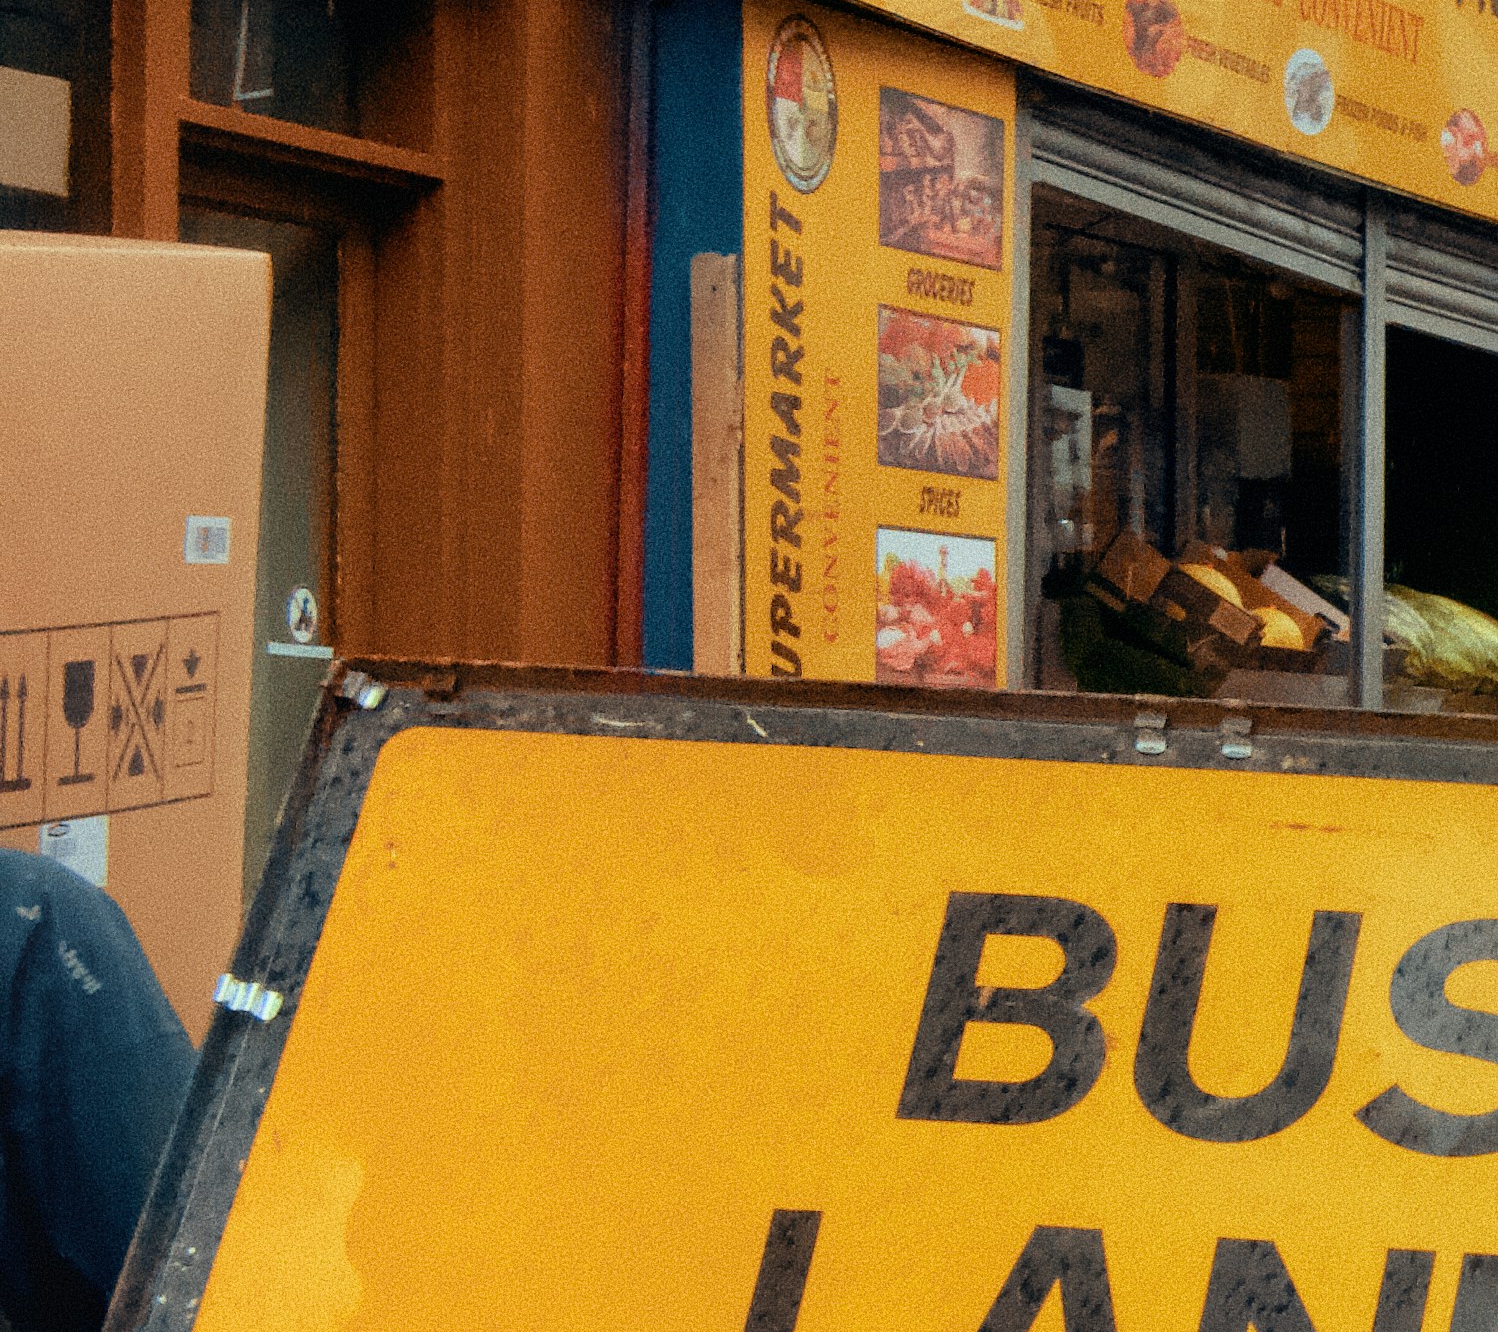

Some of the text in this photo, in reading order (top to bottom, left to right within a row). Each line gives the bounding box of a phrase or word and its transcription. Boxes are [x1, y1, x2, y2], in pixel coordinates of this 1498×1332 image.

[1186, 35, 1271, 84] FRESH VEGETABLES
[906, 270, 977, 308] GROCERIES
[769, 190, 805, 682] UPERMARKET
[821, 368, 843, 645] CONVENIENT
[919, 485, 961, 518] SPICES
